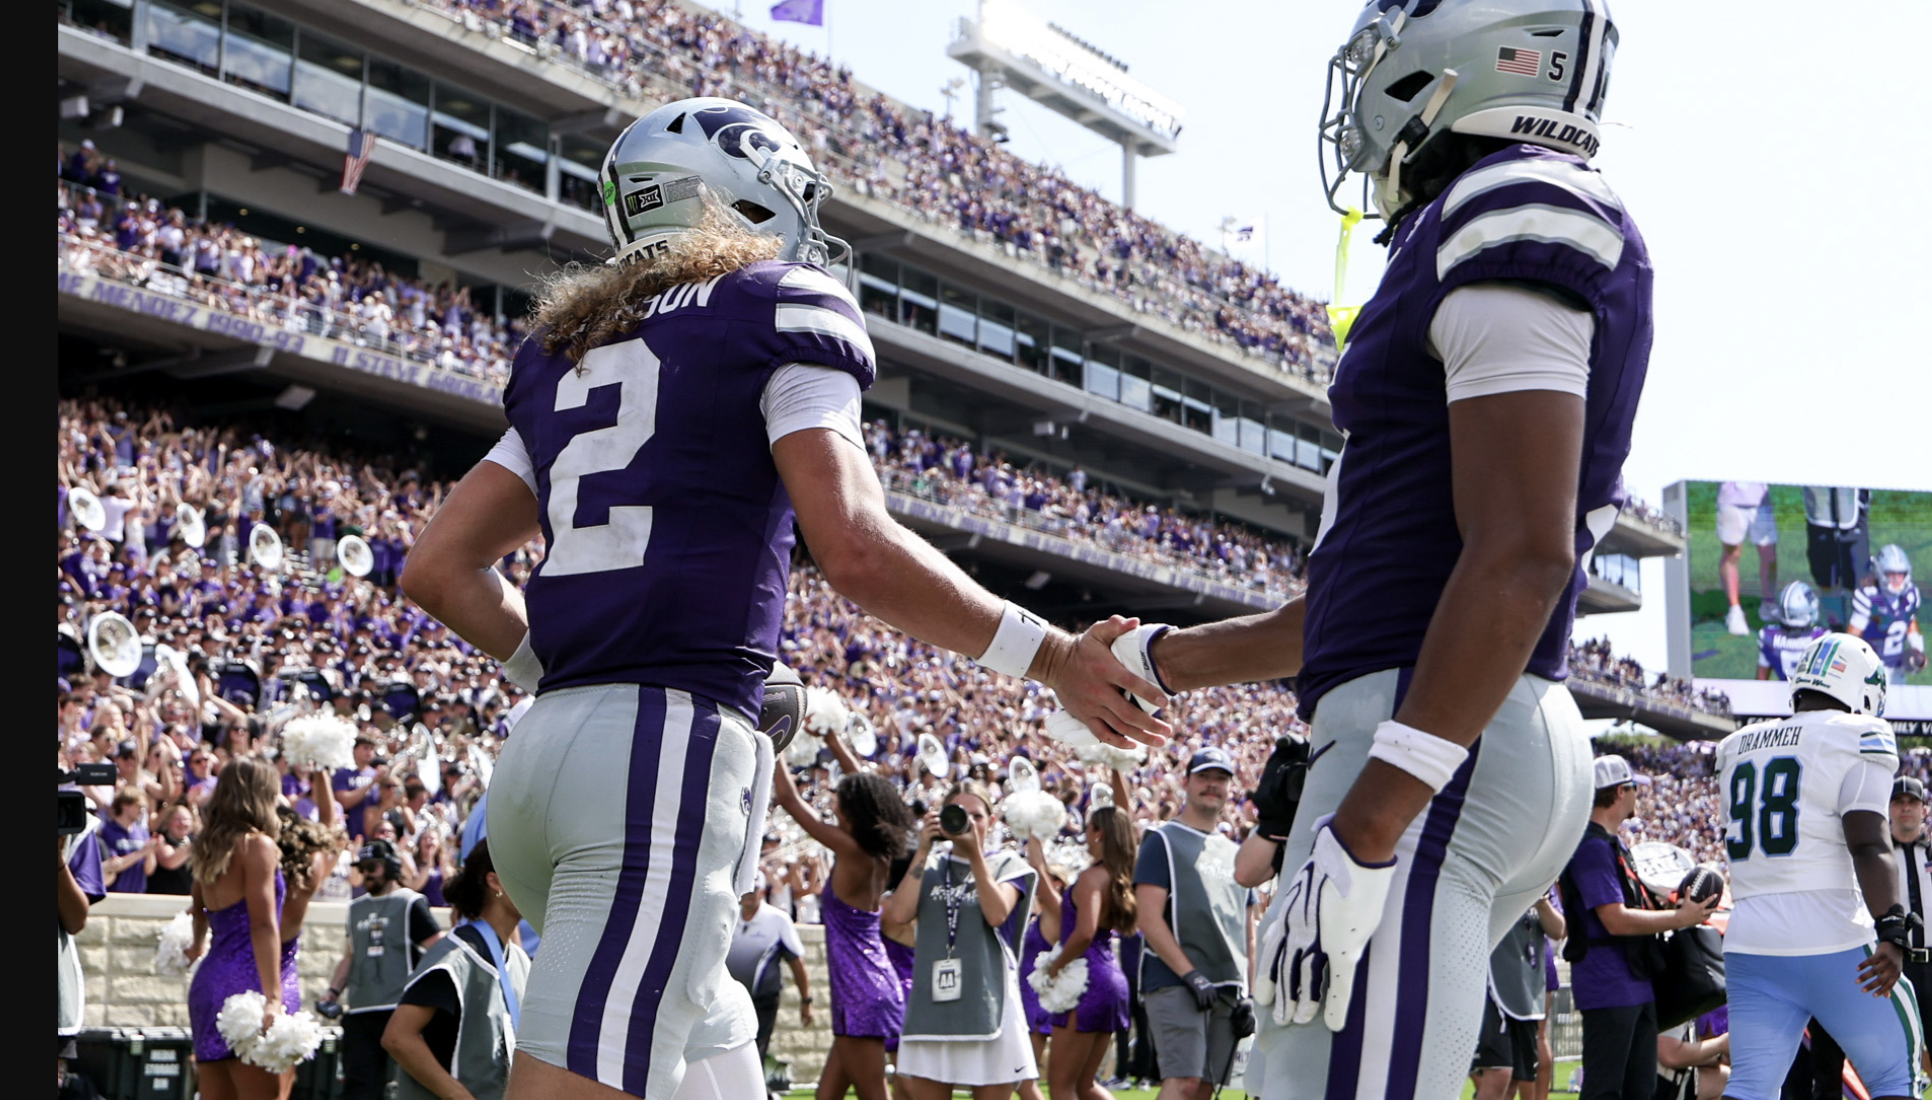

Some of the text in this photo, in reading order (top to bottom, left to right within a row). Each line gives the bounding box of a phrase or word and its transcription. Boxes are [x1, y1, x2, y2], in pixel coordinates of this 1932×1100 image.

[1548, 51, 1567, 81] 5
[92, 281, 199, 325] MENDEZ
[207, 311, 305, 354] 1990-93
[356, 351, 419, 384] STEVE
[428, 370, 504, 405] GROGA
[539, 337, 660, 577] 2
[1883, 620, 1907, 656] 2
[1738, 726, 1802, 755] DRAMMEH
[1725, 755, 1803, 862] 98
[941, 973, 954, 988] AA
